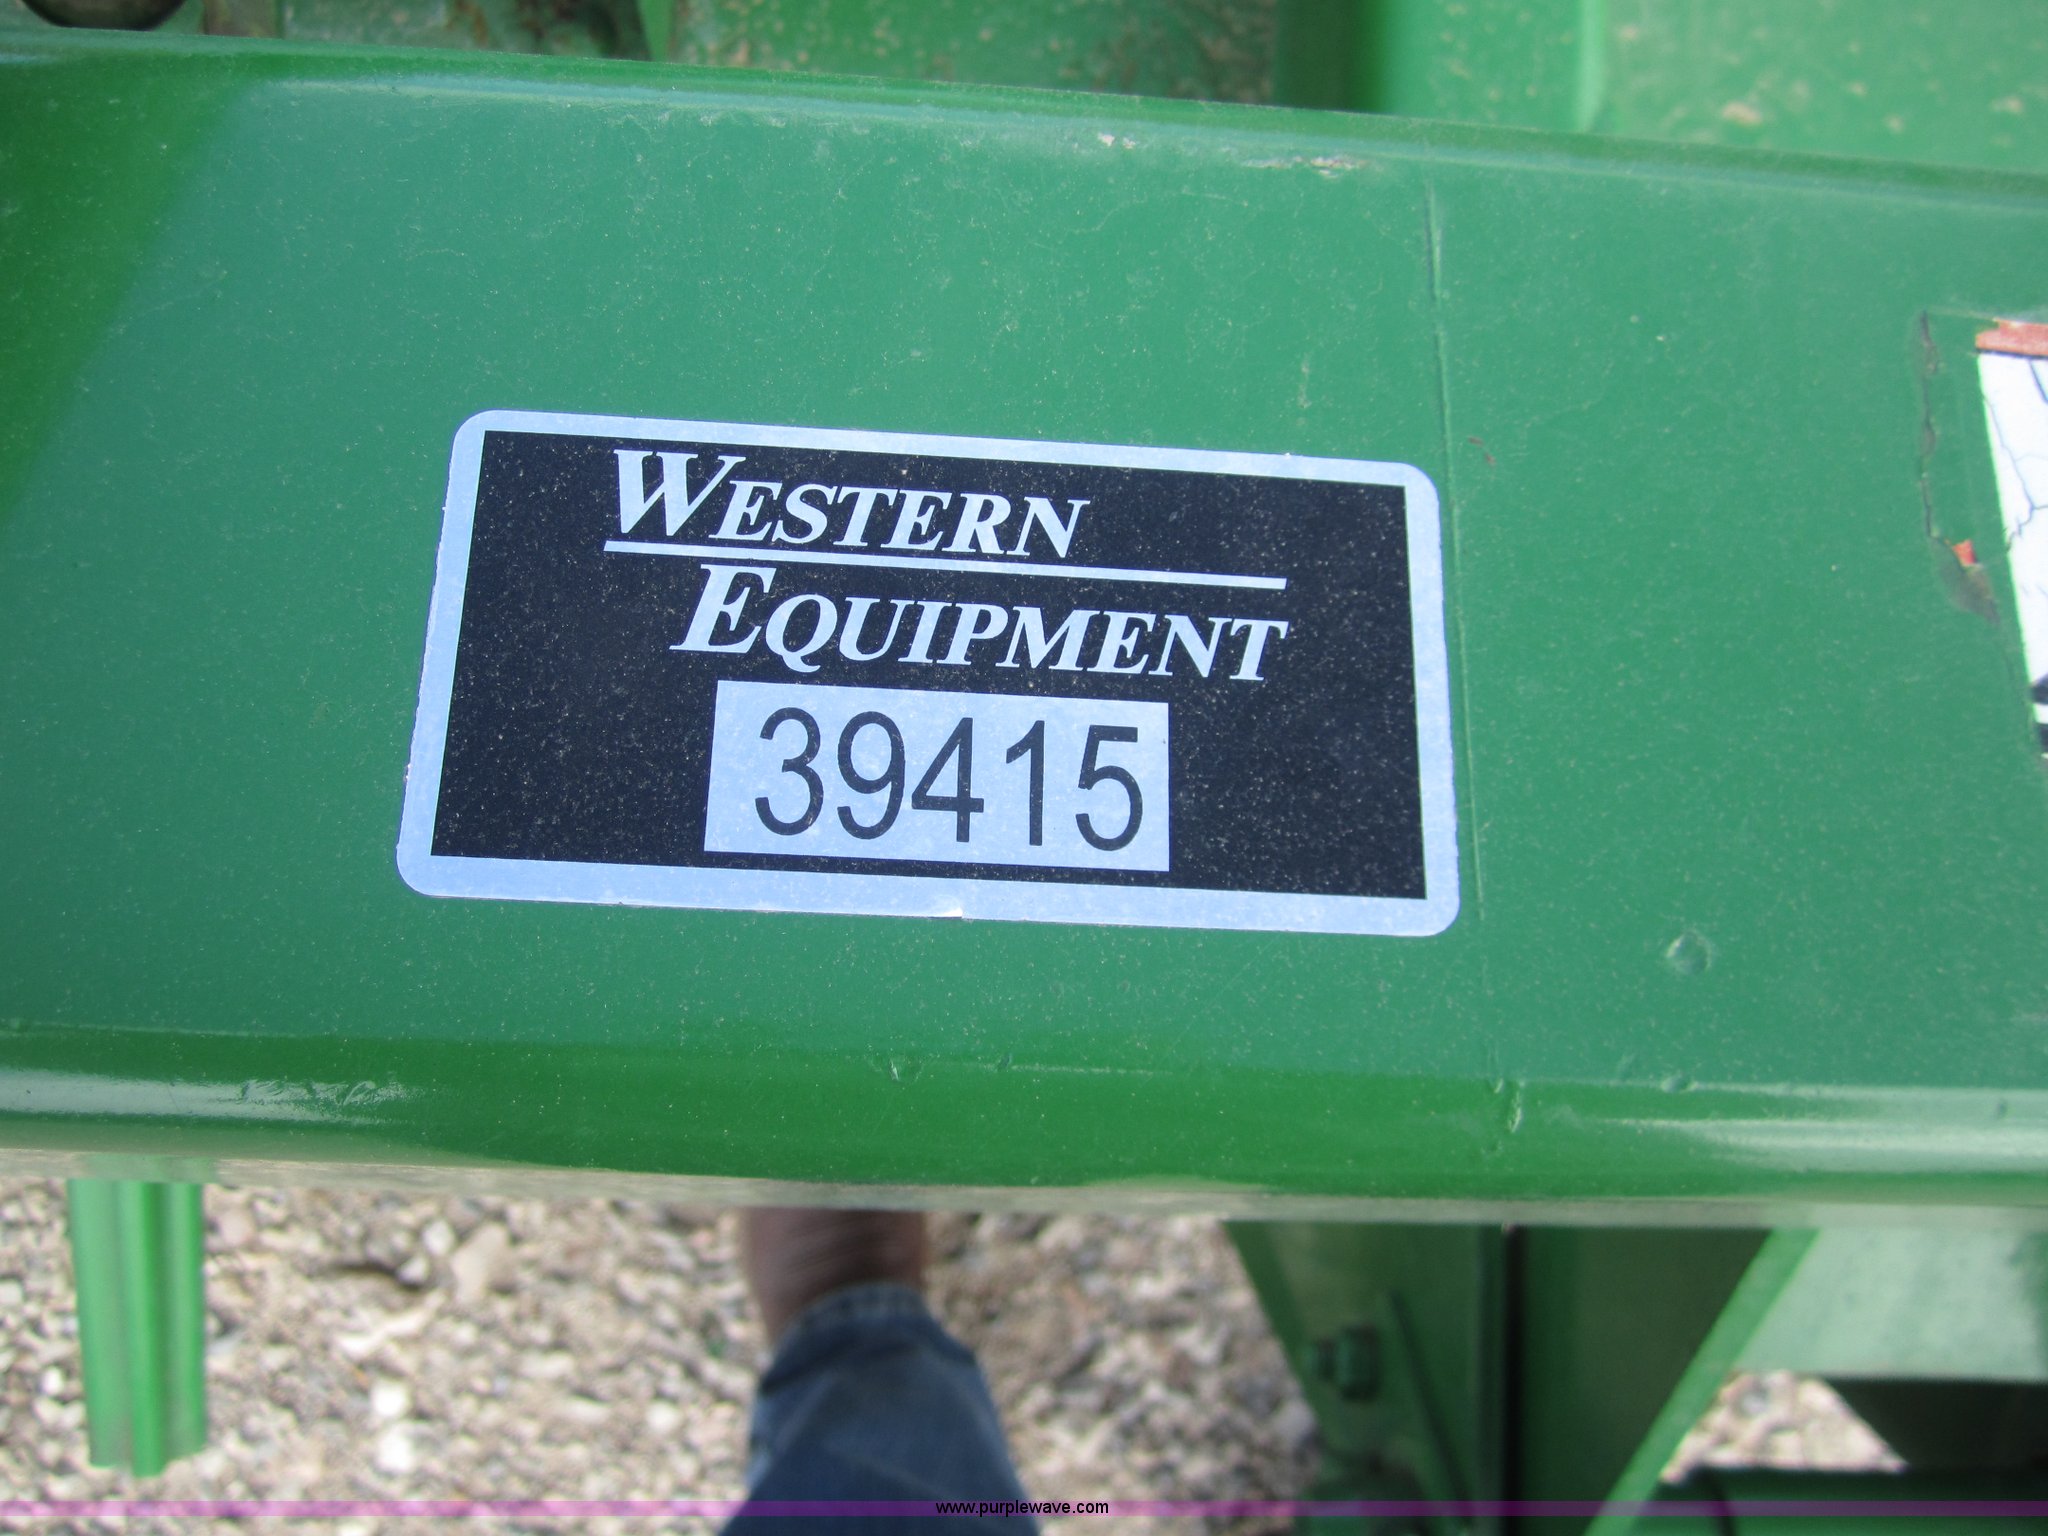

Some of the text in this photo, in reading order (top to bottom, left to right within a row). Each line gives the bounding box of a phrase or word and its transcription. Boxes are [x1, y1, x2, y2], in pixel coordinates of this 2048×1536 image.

[612, 448, 1091, 559] WESTERN
[668, 563, 1290, 682] EQUIPMENT
[755, 707, 1143, 852] 39415
